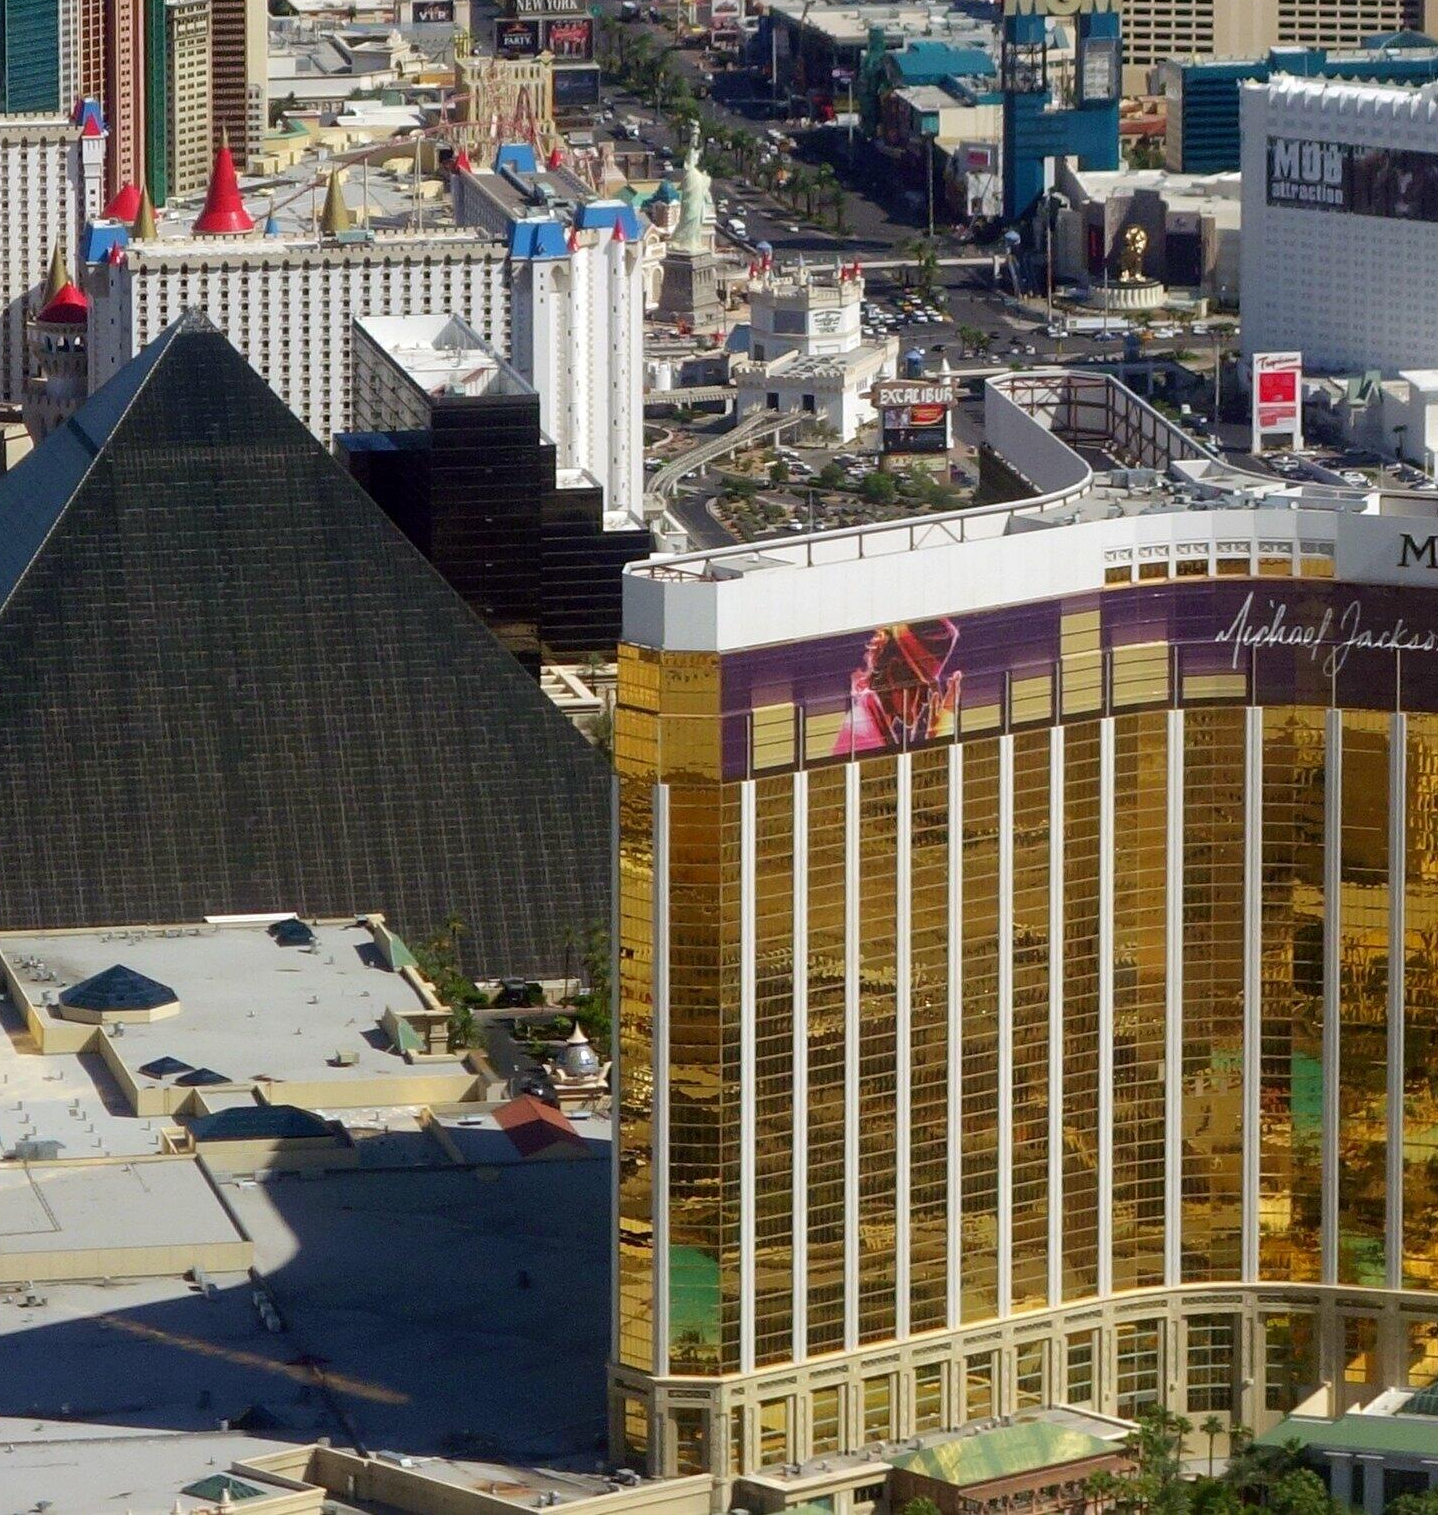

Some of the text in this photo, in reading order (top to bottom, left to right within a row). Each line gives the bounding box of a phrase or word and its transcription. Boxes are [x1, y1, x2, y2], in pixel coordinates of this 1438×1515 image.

[1271, 138, 1343, 184] MOB
[1271, 181, 1343, 205] attraction
[879, 386, 953, 404] EXCALIBUR
[1215, 591, 1333, 670] Michael
